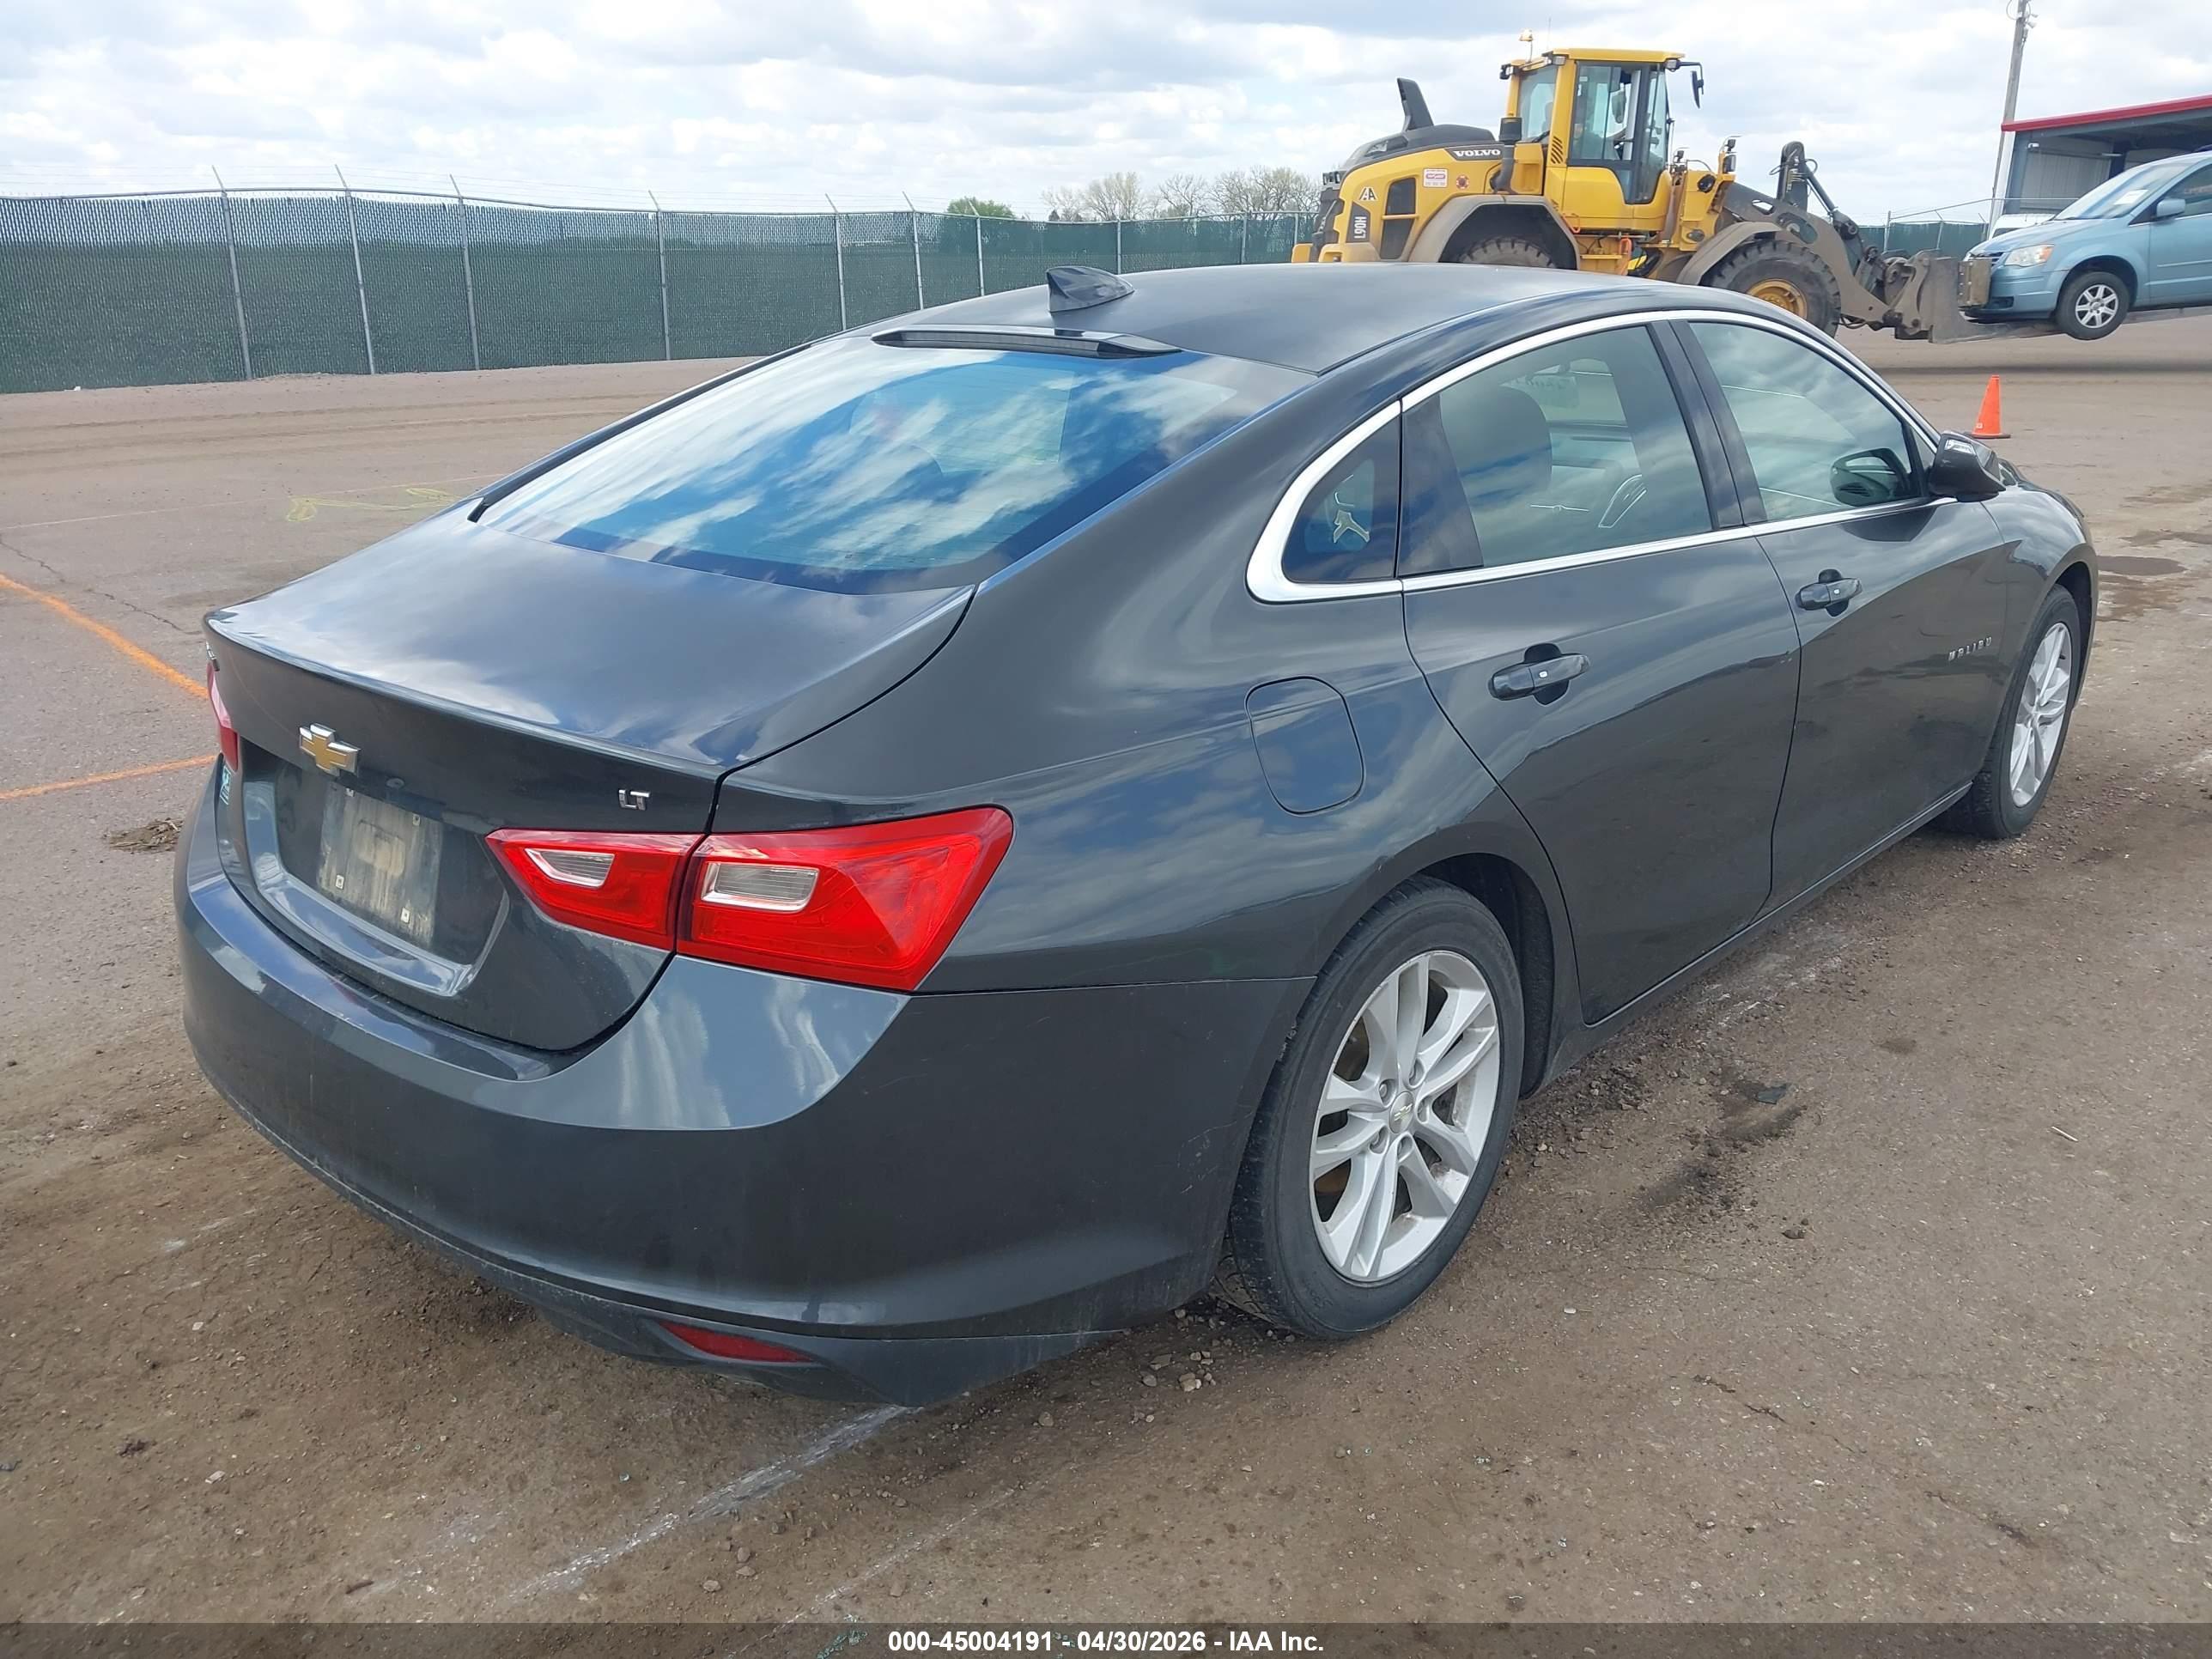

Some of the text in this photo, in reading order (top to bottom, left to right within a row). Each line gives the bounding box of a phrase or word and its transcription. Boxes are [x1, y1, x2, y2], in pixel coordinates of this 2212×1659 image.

[1453, 149, 1501, 157] VOLVO
[1353, 216, 1367, 239] L90H
[1948, 636, 1992, 662] MALIBU
[618, 789, 650, 811] LT
